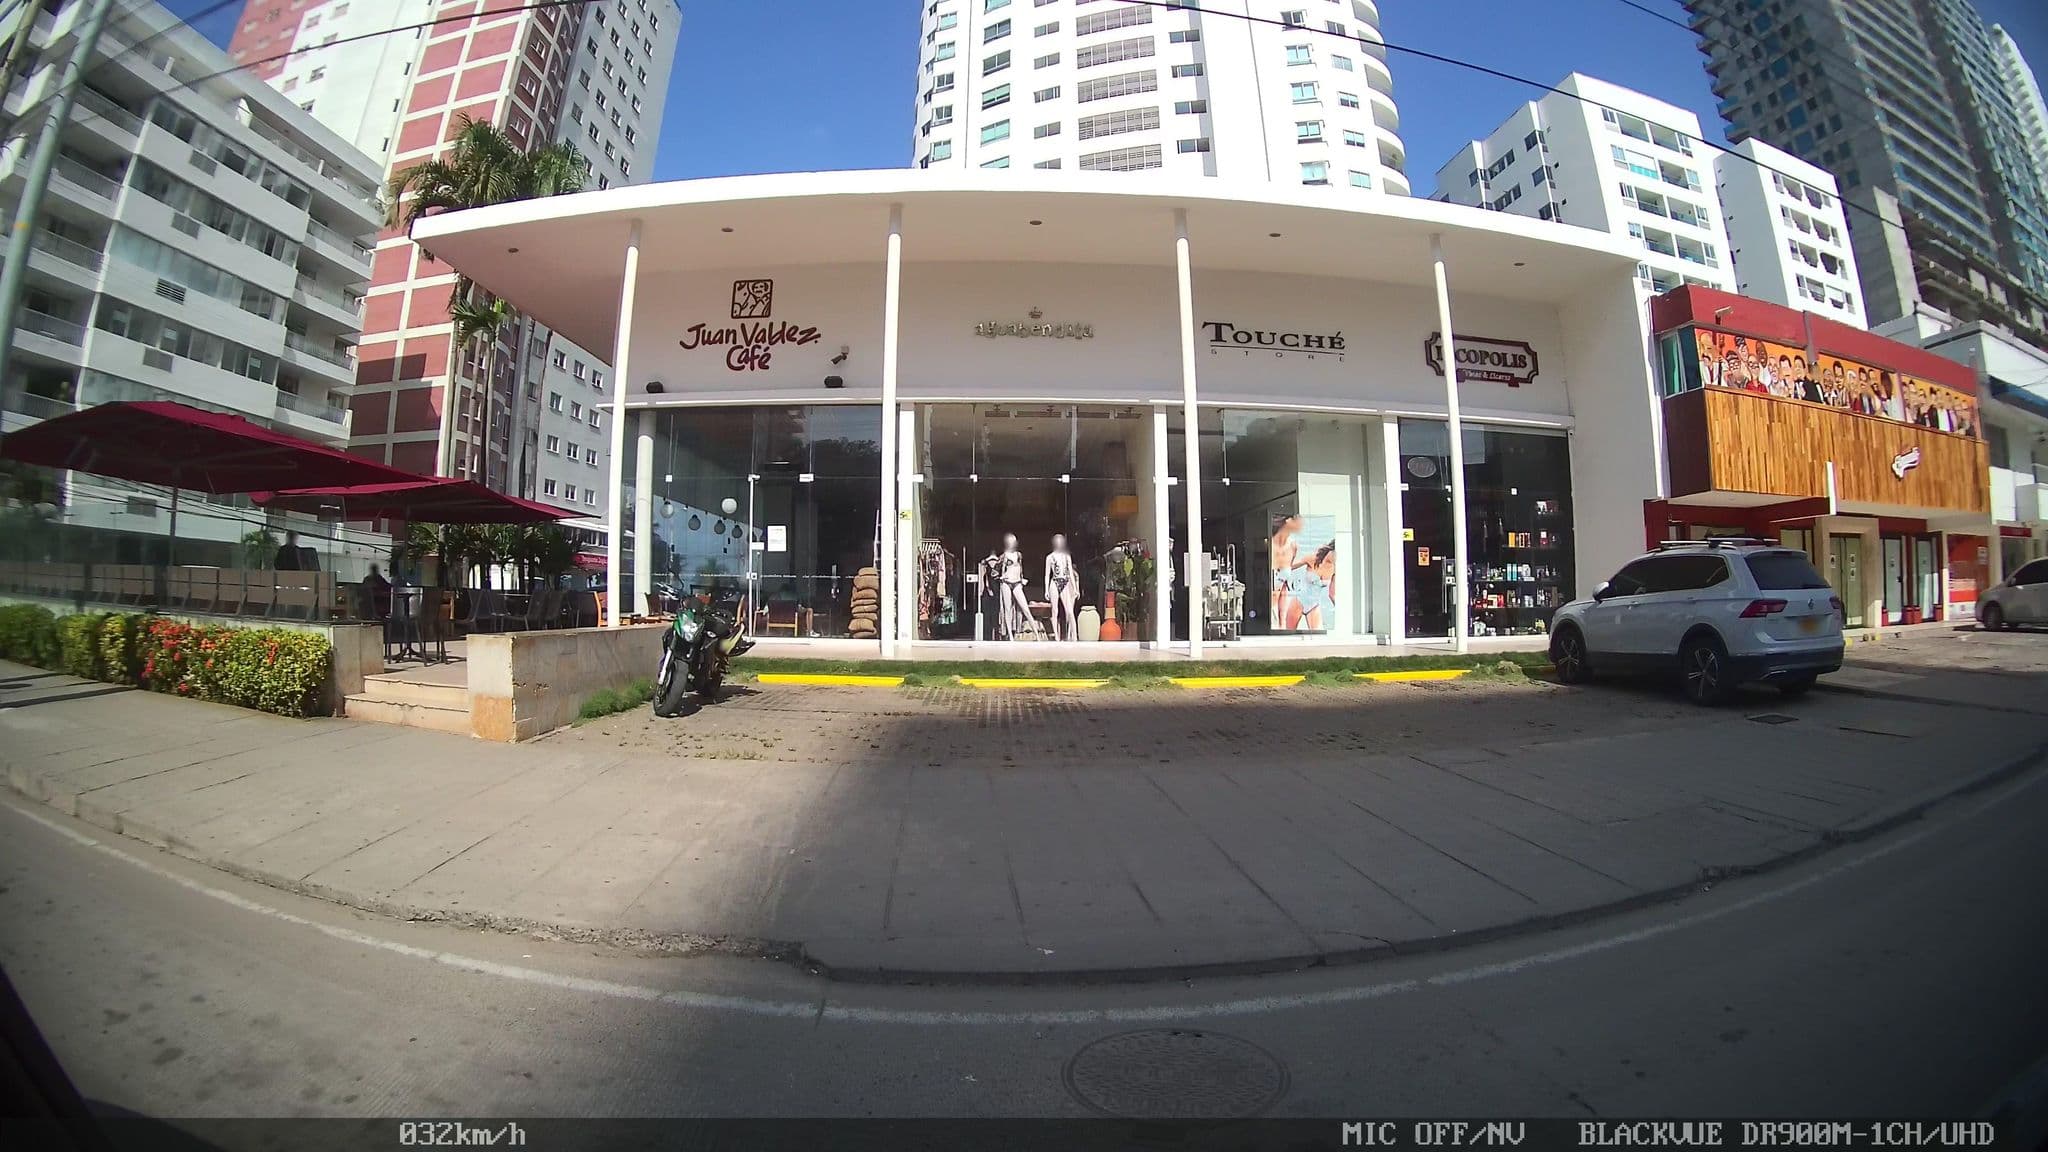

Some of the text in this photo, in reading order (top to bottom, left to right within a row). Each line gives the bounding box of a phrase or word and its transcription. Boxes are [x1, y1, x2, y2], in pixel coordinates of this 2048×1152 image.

[679, 321, 822, 350] Juan Valdez
[726, 345, 773, 371] Café
